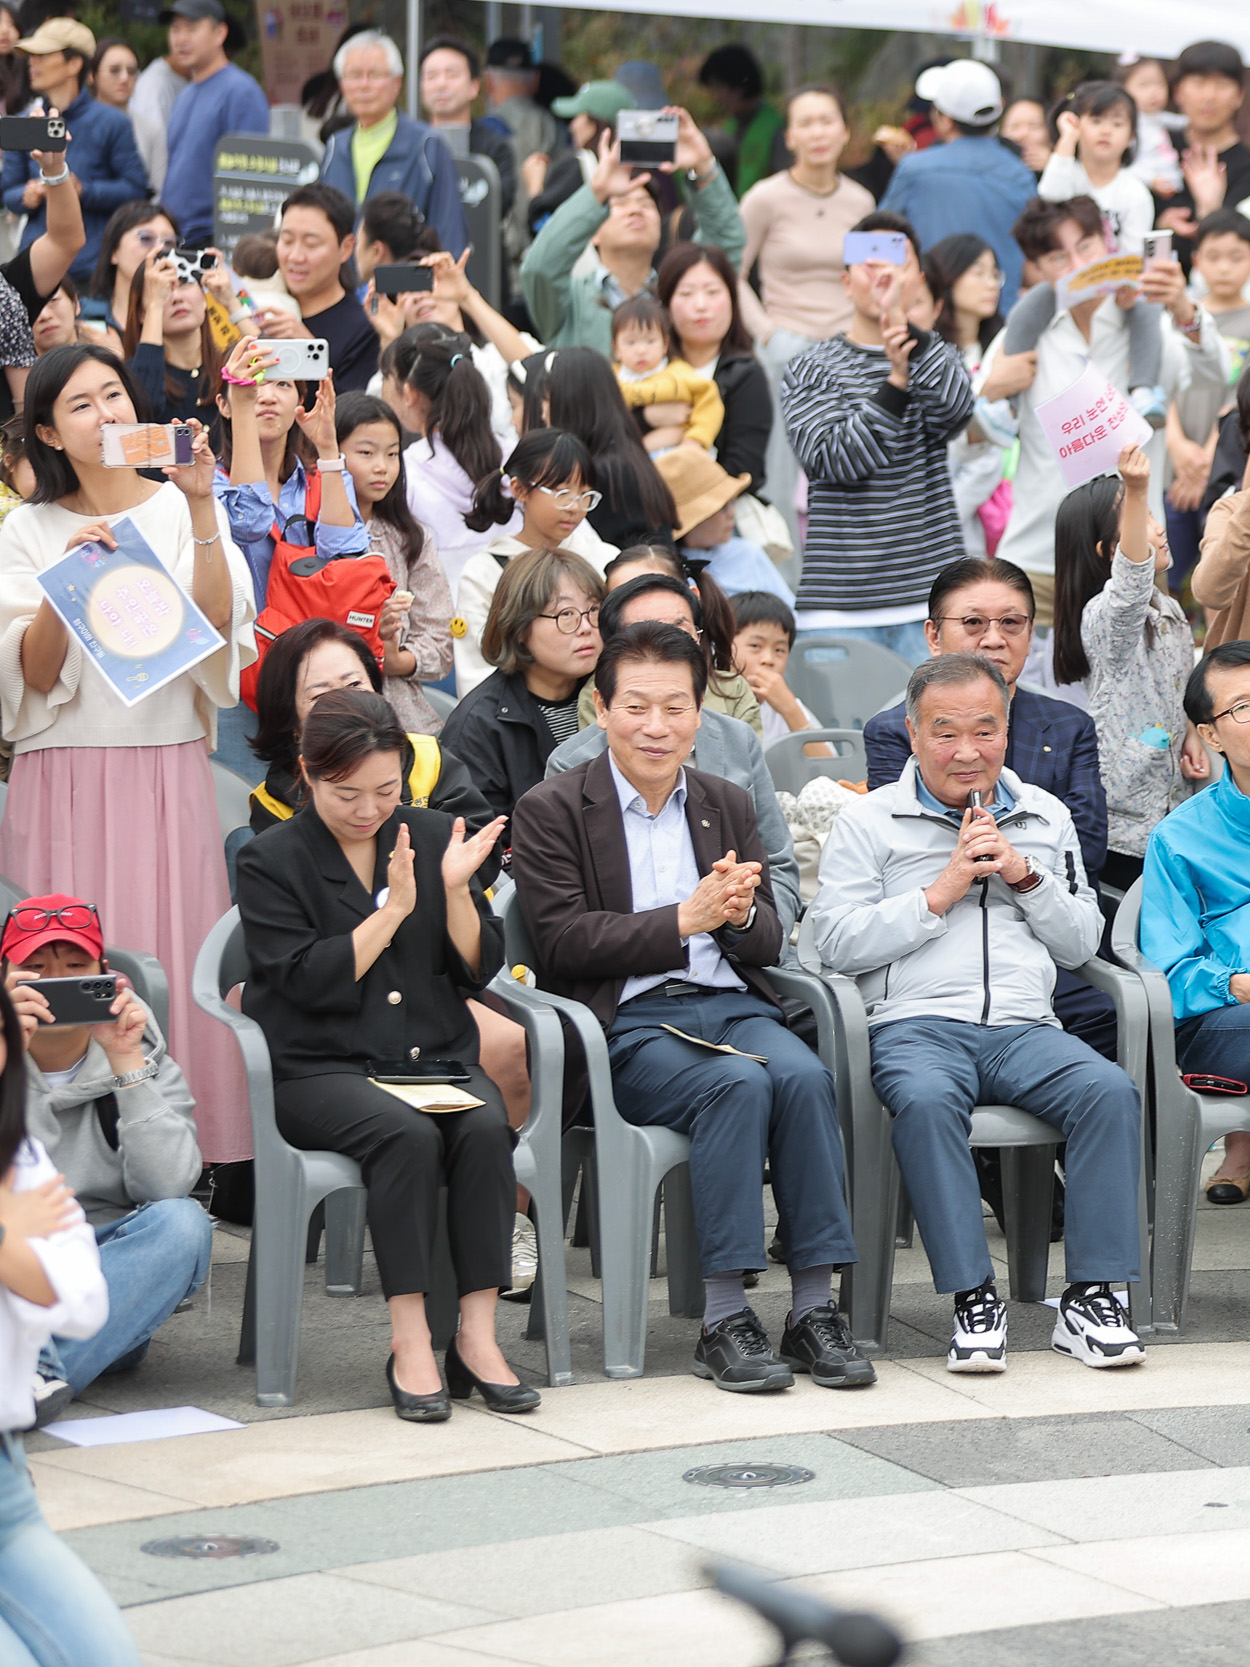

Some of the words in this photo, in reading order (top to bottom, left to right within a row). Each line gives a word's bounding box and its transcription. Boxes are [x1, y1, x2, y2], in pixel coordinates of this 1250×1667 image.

[1061, 414, 1085, 435] 우리
[1060, 424, 1108, 458] 아름다운
[116, 586, 158, 637] 주인공은
[349, 615, 373, 624] HUNTER
